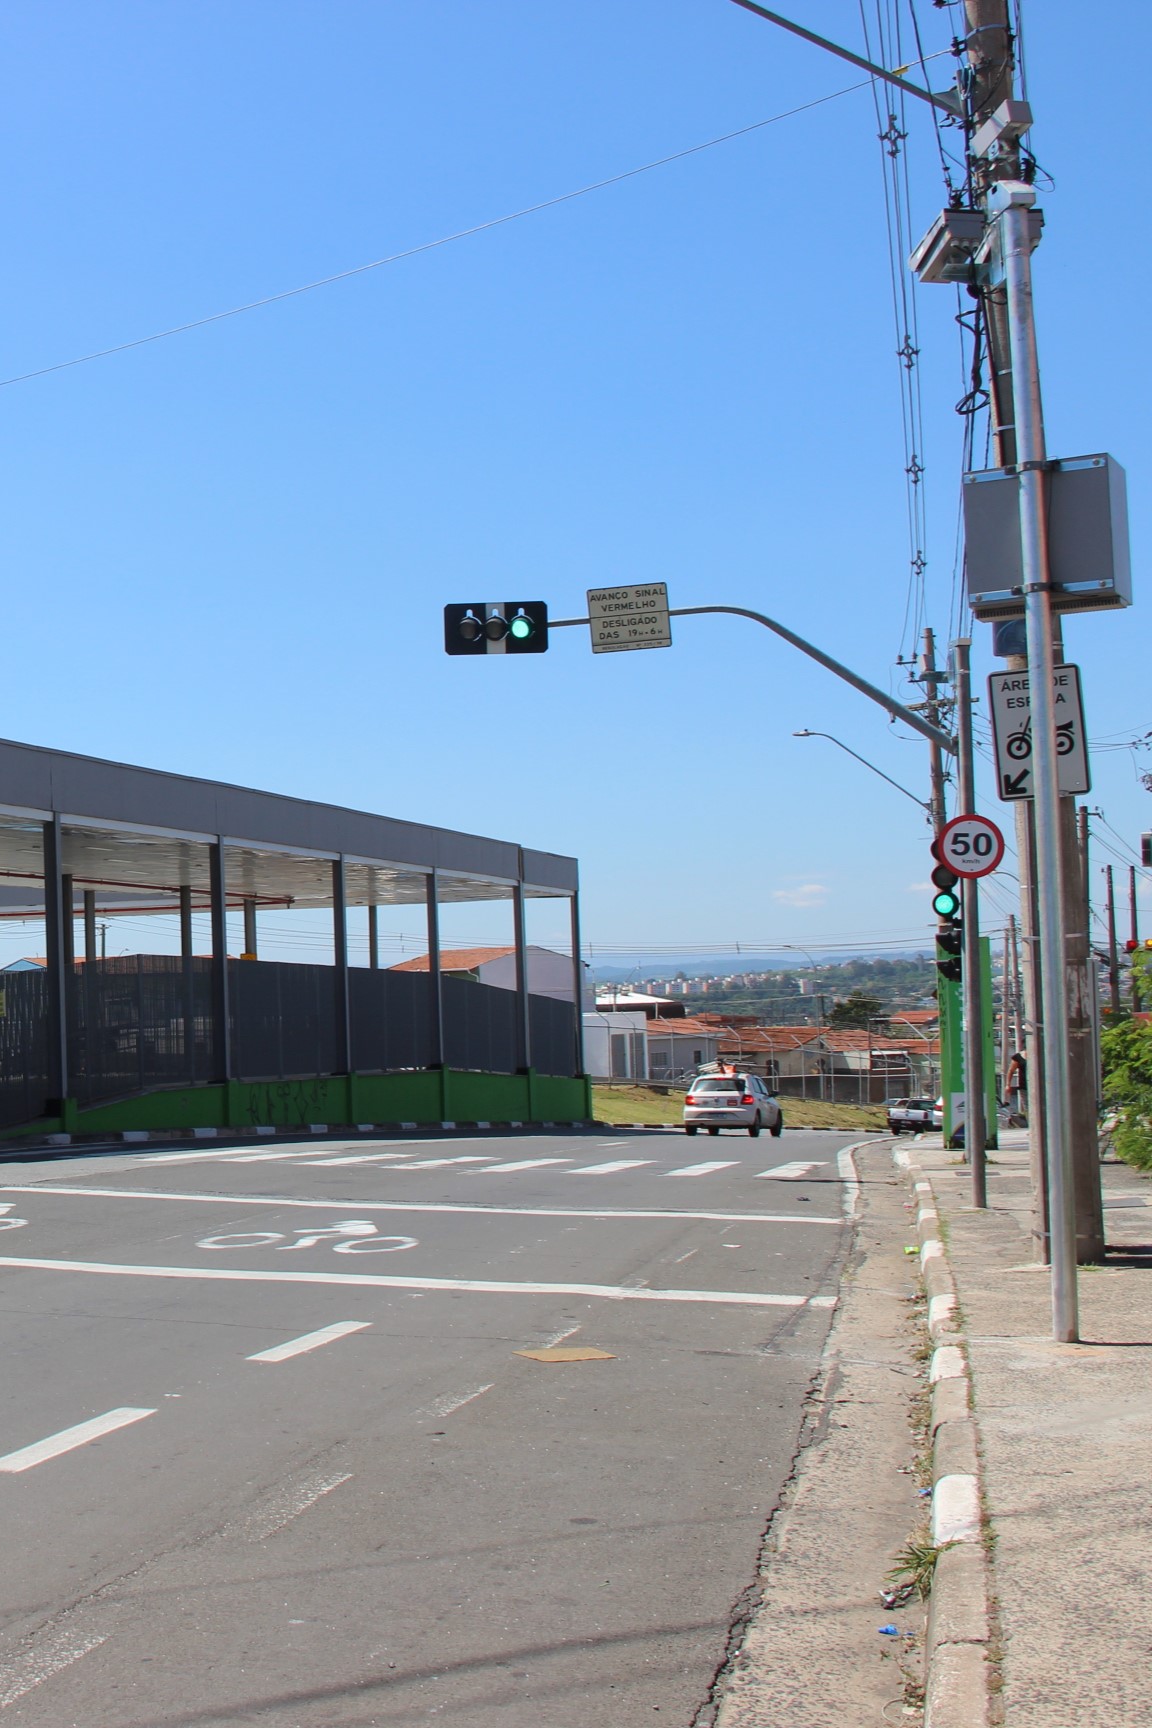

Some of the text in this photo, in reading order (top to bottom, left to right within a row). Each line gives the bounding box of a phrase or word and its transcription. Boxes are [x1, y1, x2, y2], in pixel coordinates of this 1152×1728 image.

[635, 588, 666, 598] SINAL
[601, 600, 656, 612] VERMELHO
[602, 616, 657, 628] DESLIGADO
[599, 631, 620, 640] DAS
[1001, 679, 1030, 692] ÁRE
[950, 832, 993, 857] 50
